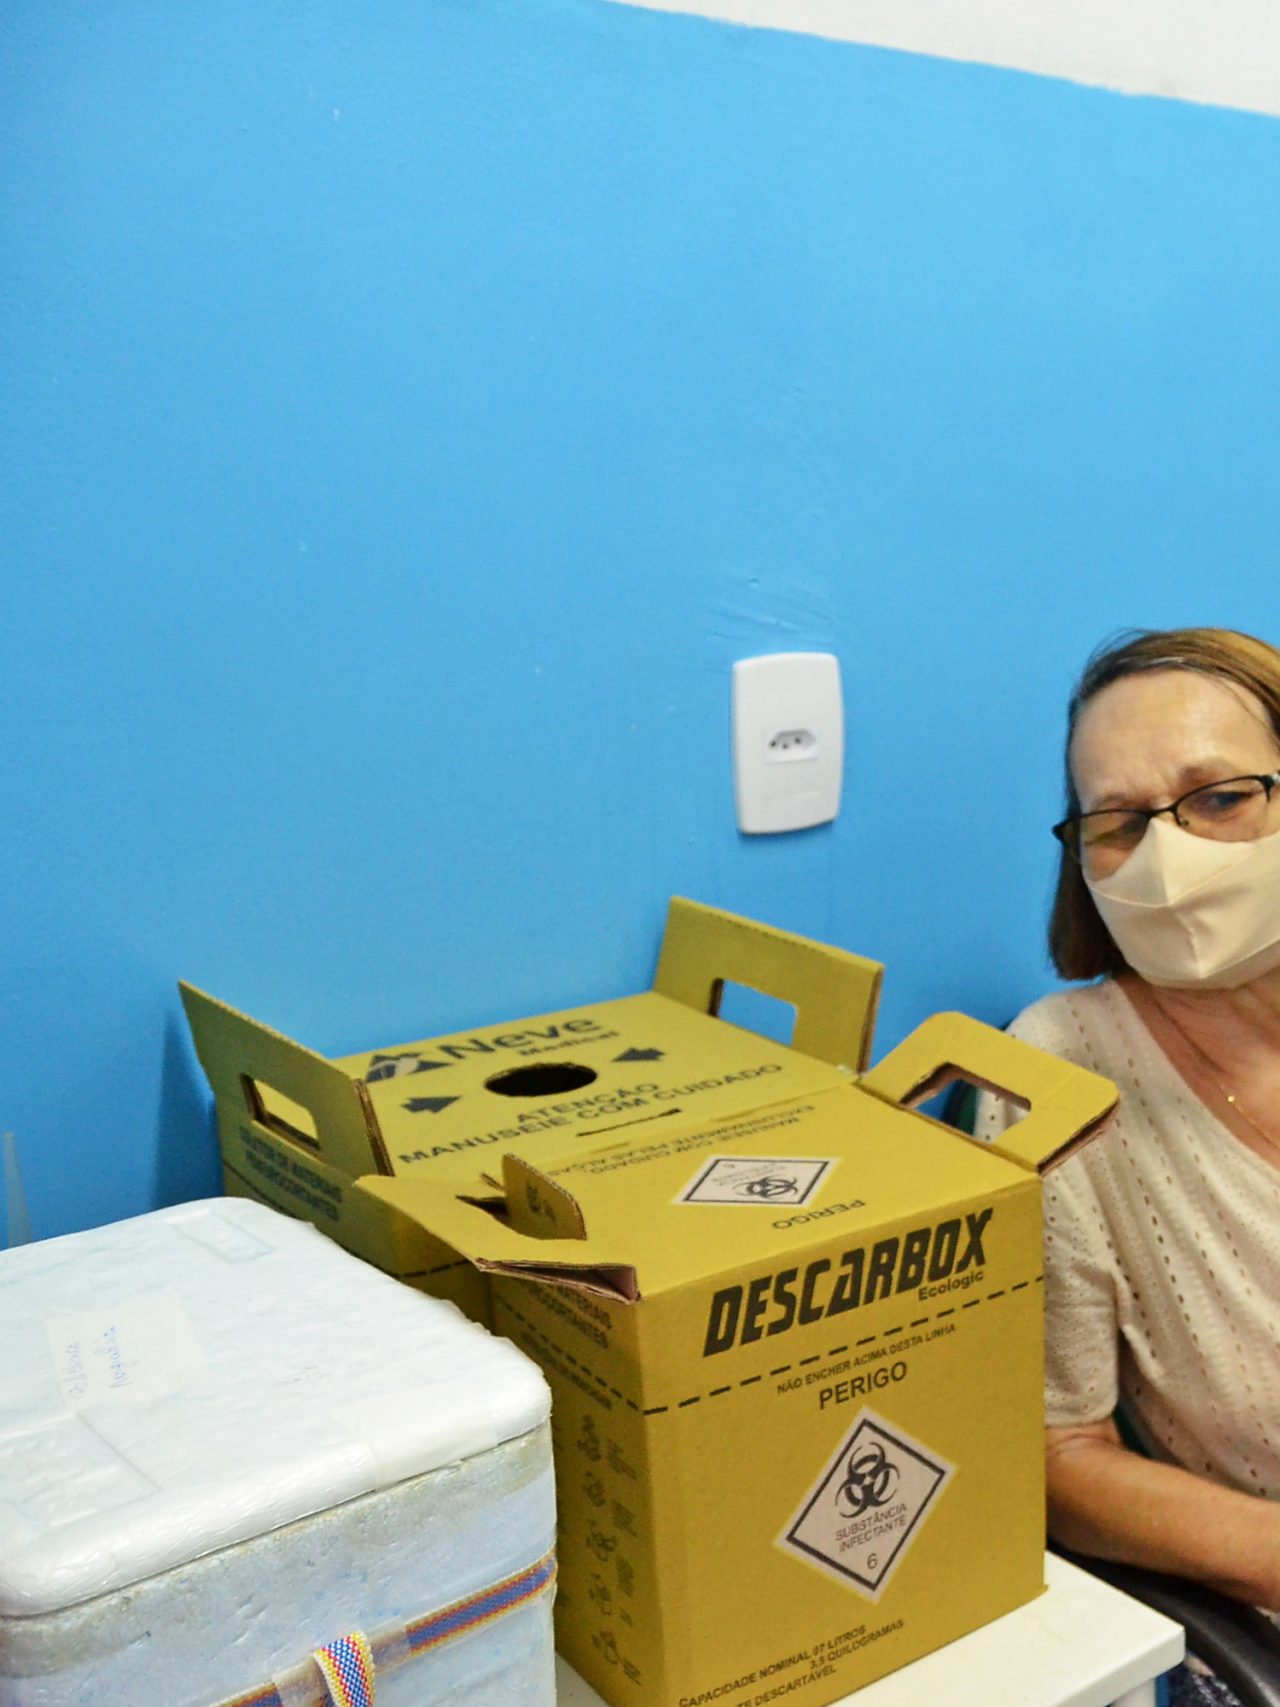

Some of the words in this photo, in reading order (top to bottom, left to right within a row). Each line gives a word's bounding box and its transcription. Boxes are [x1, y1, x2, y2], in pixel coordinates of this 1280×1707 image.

[438, 1019, 602, 1060] Neve
[398, 1116, 573, 1164] MANUSEIE
[577, 1097, 648, 1119] COM
[652, 1064, 782, 1100] CUIDADO
[517, 1083, 659, 1123] ATENÇÃO
[772, 1199, 866, 1230] PERIGO
[702, 1207, 993, 1358] DESCARBOX
[918, 1270, 984, 1301] Ecologic
[777, 1377, 803, 1395] NÃO
[805, 1360, 850, 1386] ENCHER
[853, 1347, 888, 1367] ACIMA
[889, 1334, 923, 1354] DESTA
[925, 1323, 957, 1343] LINHA
[819, 1360, 908, 1410] PERIGO
[835, 1502, 908, 1542] SUBSTÂNCIA
[839, 1514, 907, 1553] INFECTANTE
[866, 1552, 879, 1570] 6
[678, 1672, 757, 1707] CAPACIDADE
[758, 1650, 811, 1680] NOMINAL
[827, 1624, 867, 1650] LITROS
[754, 1664, 838, 1705] DESCARTÁVEL
